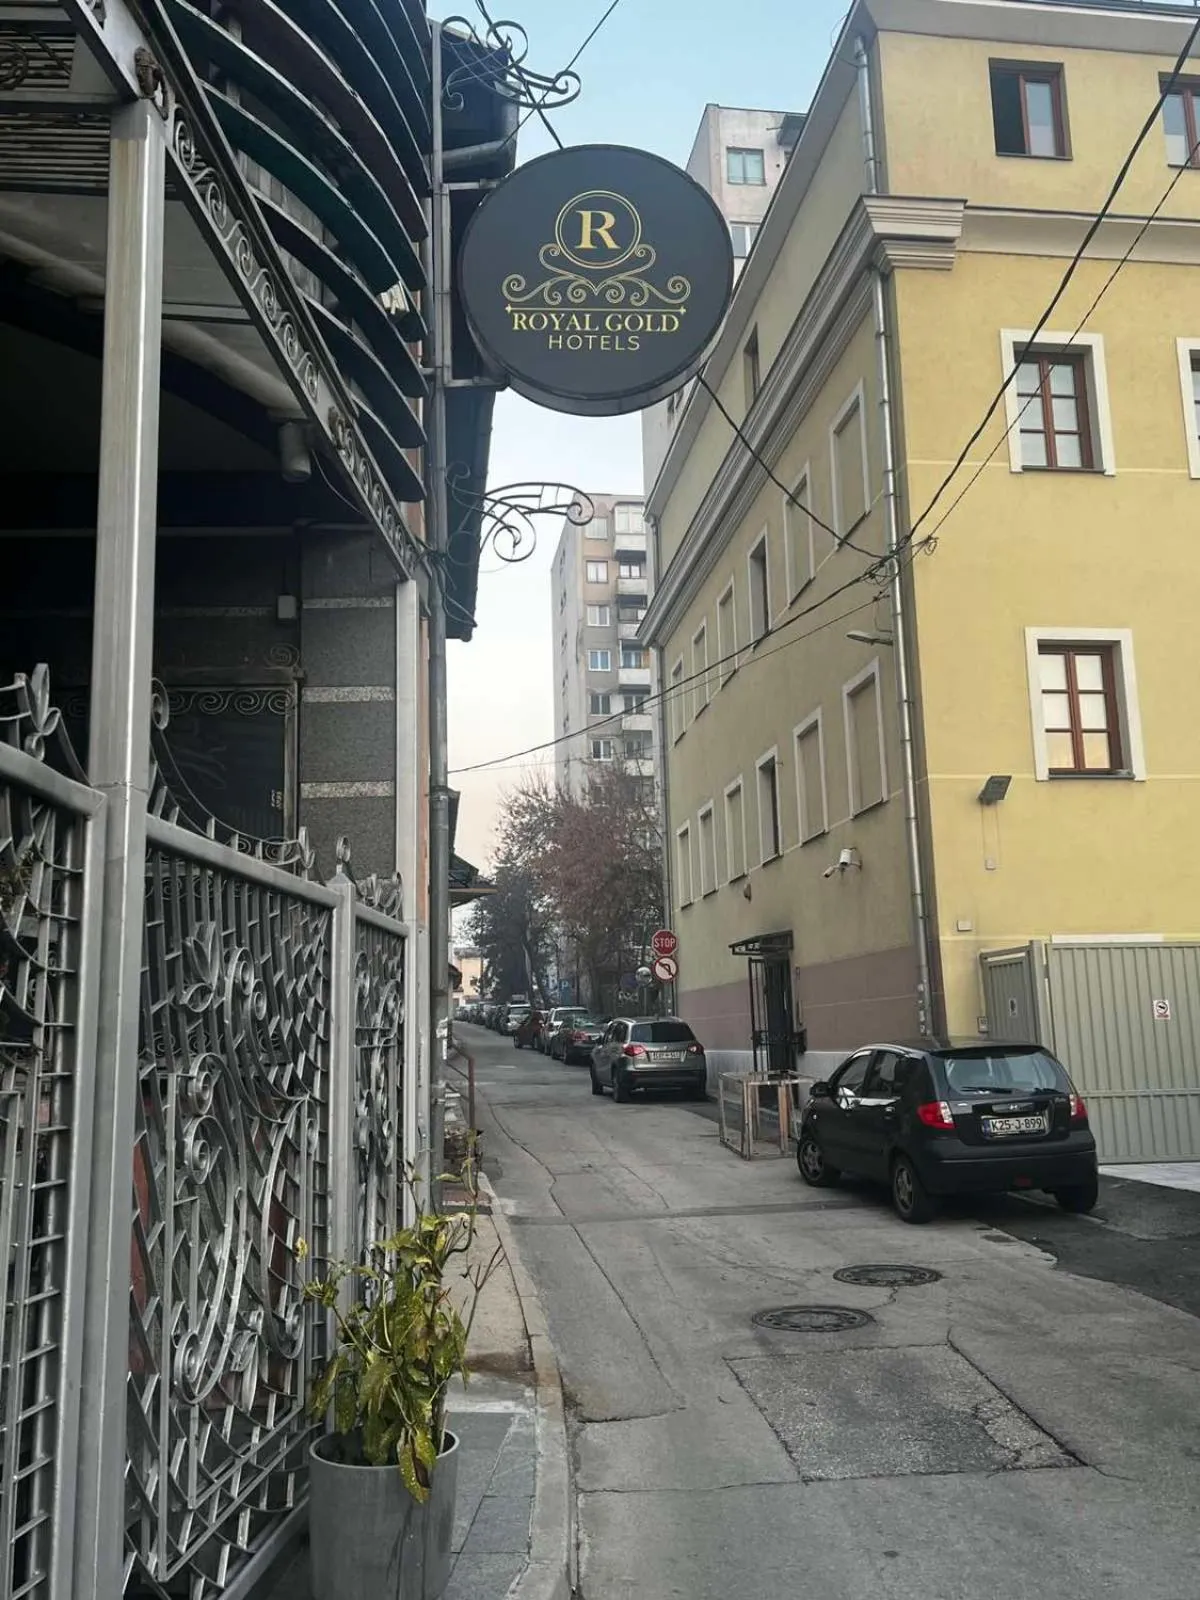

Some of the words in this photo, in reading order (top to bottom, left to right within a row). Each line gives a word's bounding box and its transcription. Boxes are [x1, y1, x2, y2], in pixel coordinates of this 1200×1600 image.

[575, 209, 621, 249] R
[512, 313, 599, 331] ROYAL
[605, 313, 680, 332] GOLD
[548, 335, 640, 351] HOTELS
[654, 937, 675, 948] STOP
